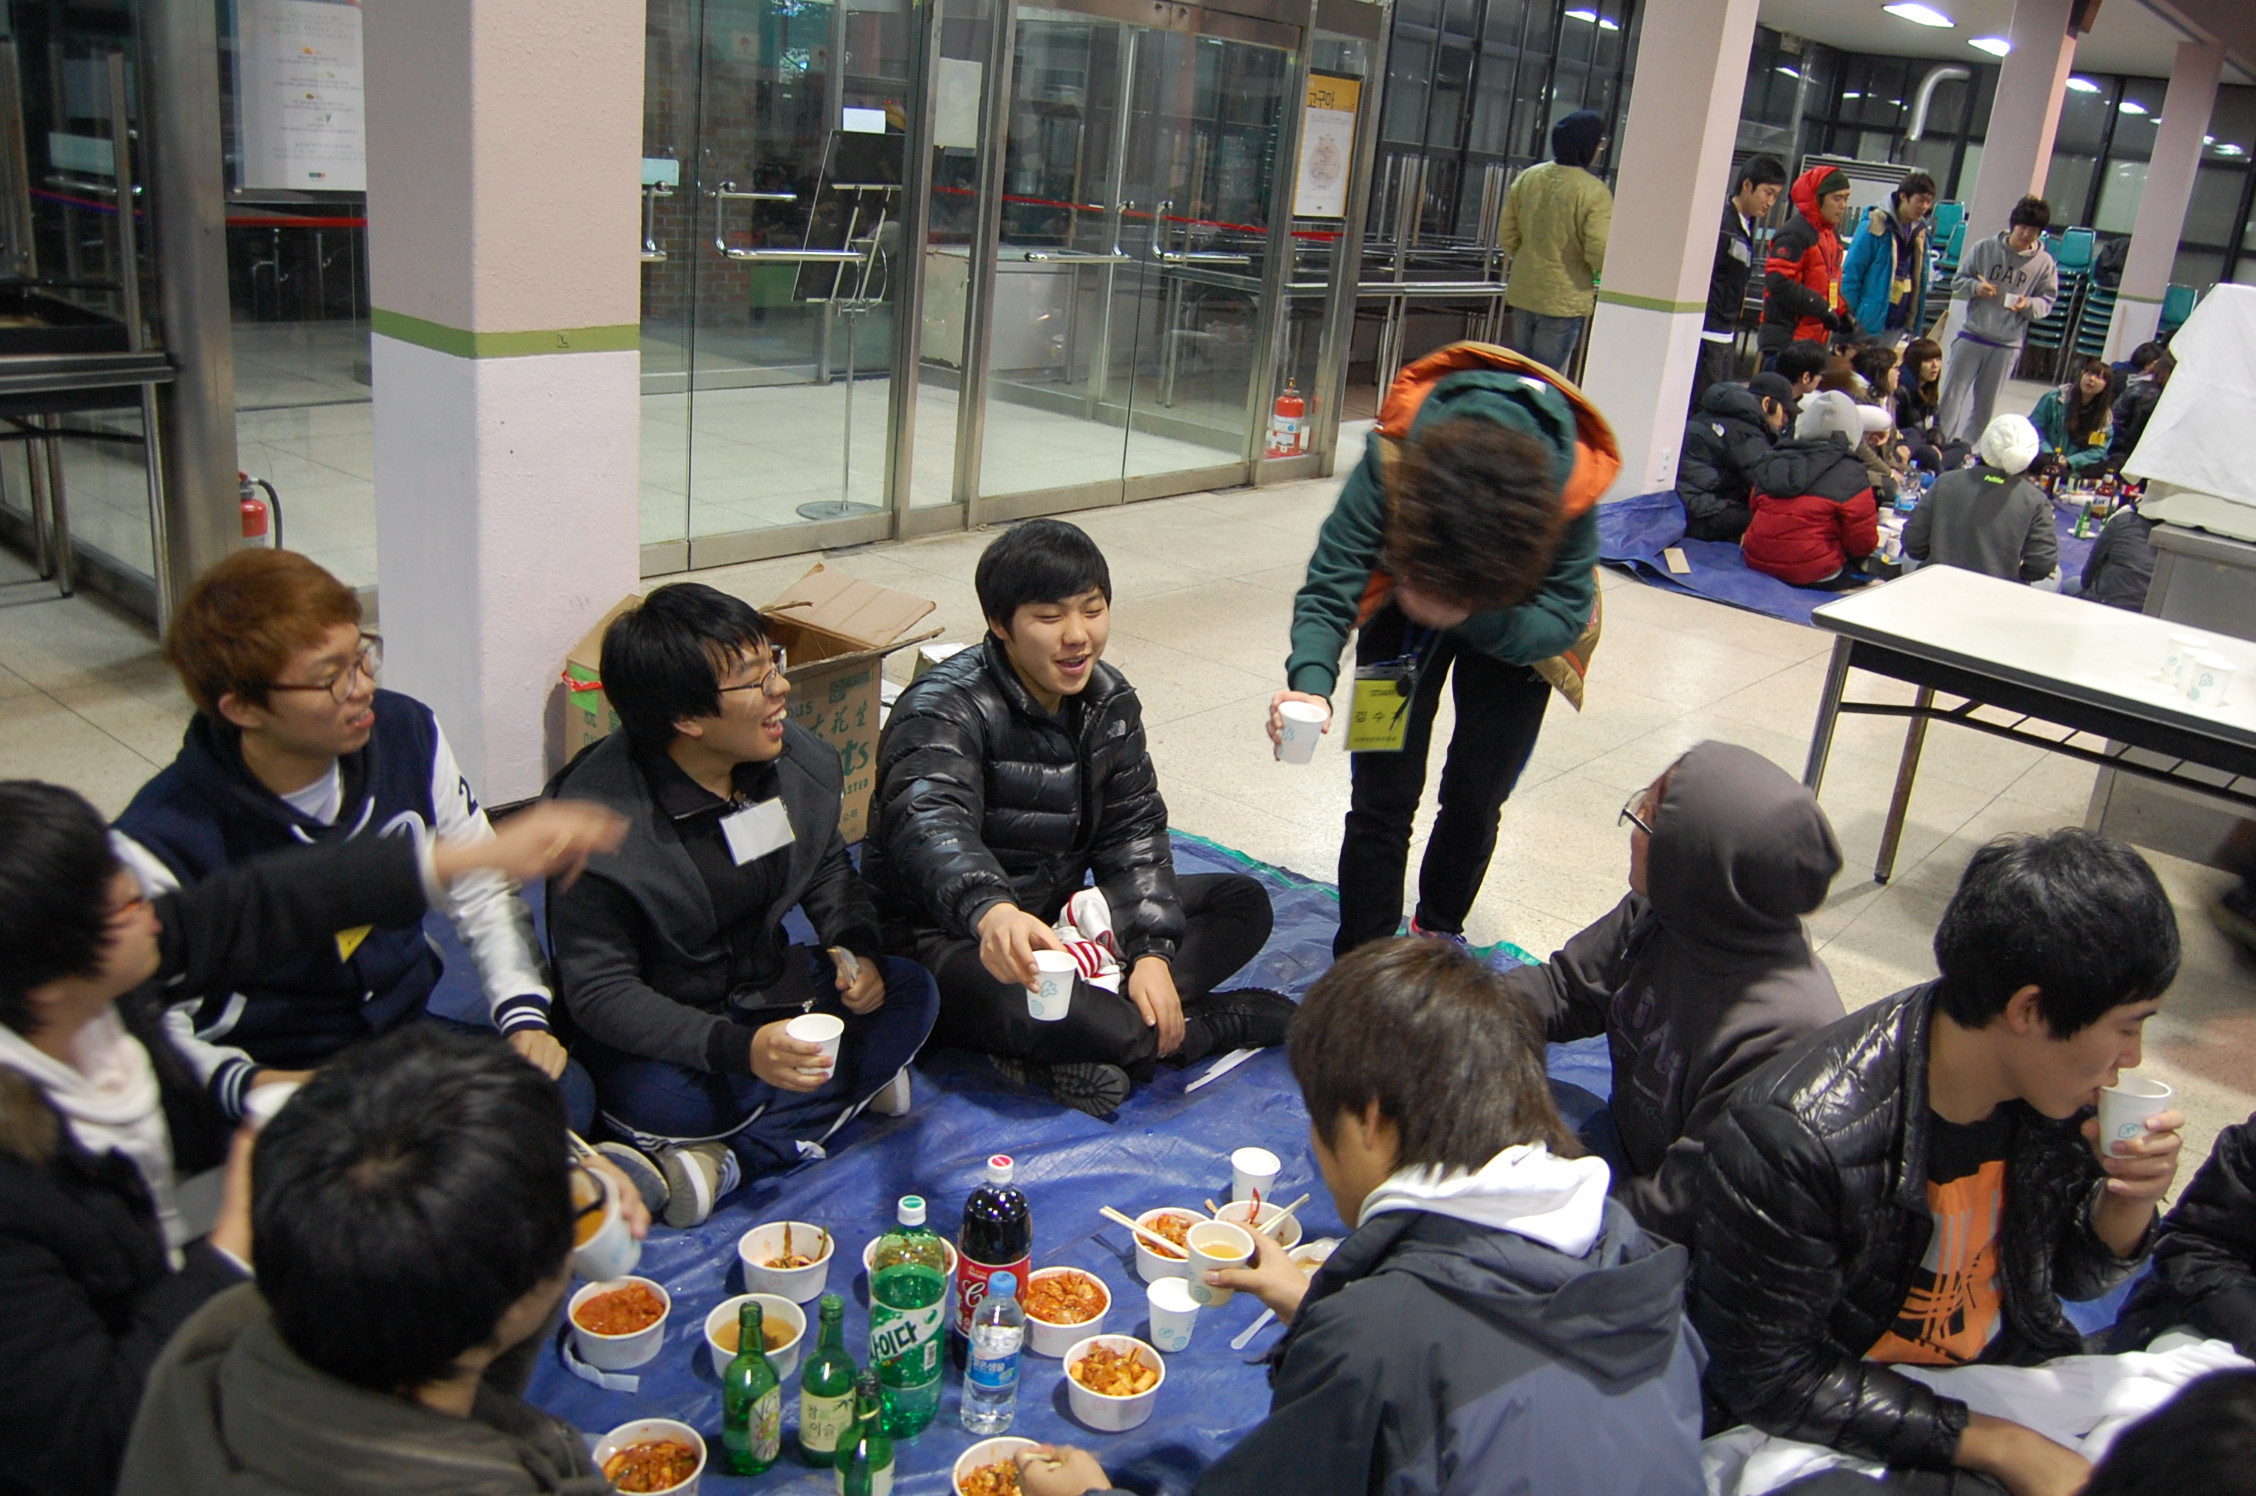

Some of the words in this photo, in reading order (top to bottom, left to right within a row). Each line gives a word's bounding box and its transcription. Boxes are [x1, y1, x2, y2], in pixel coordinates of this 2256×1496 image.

[1307, 89, 1335, 110] 고구마
[1989, 264, 2028, 287] GAP
[809, 1422, 835, 1437] 이슬
